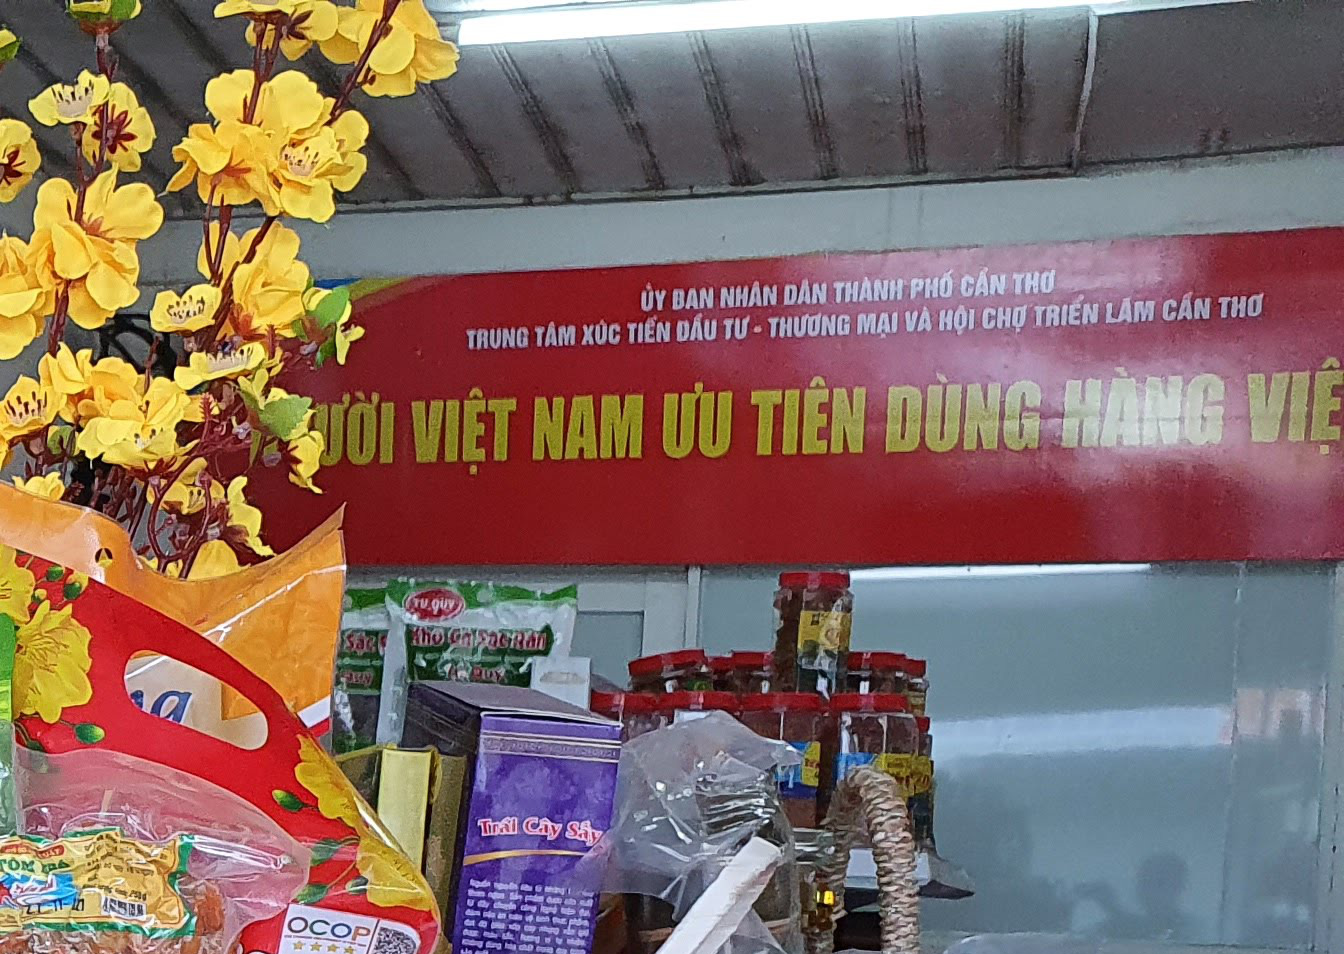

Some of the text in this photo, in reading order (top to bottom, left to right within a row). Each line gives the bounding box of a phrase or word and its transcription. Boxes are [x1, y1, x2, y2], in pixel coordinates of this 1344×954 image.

[641, 266, 1056, 312] ỦY BAN NHÂN DÂN THÀNH PHỐ CẦN THƠ
[466, 326, 529, 350] TRUNG
[534, 321, 576, 347] TÂM
[581, 319, 621, 345] XÚC
[627, 316, 671, 343] TIẾN
[676, 314, 717, 342] ĐẦU
[723, 315, 750, 340] TƯ
[767, 313, 850, 338] THƯƠNG
[856, 308, 899, 339] MẠI
[905, 305, 932, 332] VÀ
[938, 305, 976, 336] HỘI
[982, 304, 1027, 334] CHỢ
[1033, 293, 1099, 327] TRIỂN
[1105, 298, 1155, 323] LÃM
[1162, 291, 1211, 322] CẦN
[1218, 292, 1265, 319] THƠ
[313, 357, 1344, 475] ƯỜI VIỆT NAM ƯU TIÊN DÙNG HÀNG VIỆ
[523, 816, 563, 840] Cây
[287, 916, 371, 942] OCOP
